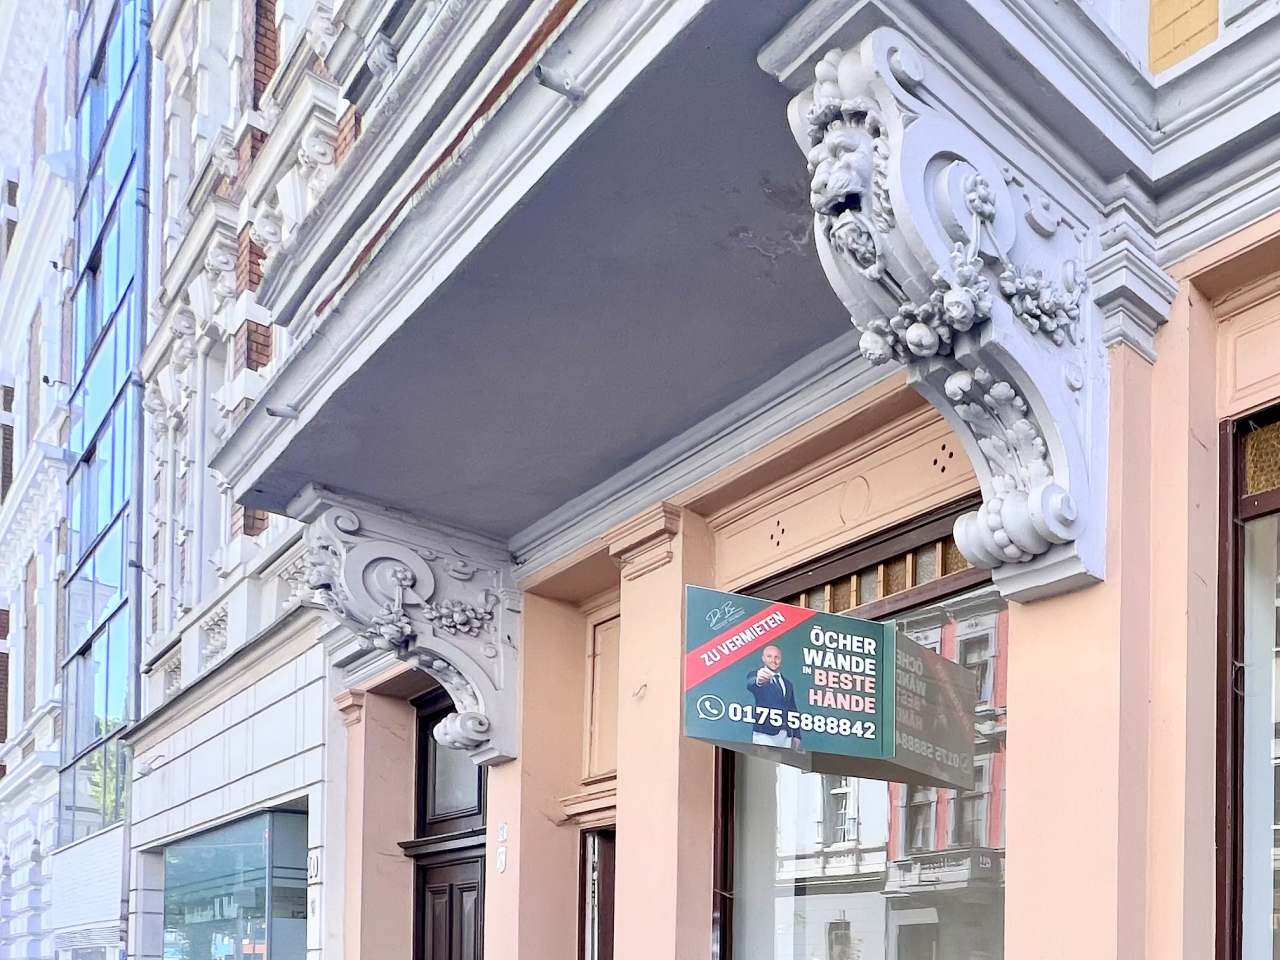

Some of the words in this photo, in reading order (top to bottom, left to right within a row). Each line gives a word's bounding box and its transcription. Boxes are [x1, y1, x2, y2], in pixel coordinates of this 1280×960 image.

[700, 649, 721, 667] ZU
[717, 611, 786, 656] VERMIETEN
[809, 625, 877, 656] ÖCHER
[802, 647, 877, 676] WÄNDE
[802, 665, 812, 675] IN
[814, 668, 876, 694] BESTE
[808, 687, 876, 714] HÄNDE
[728, 703, 783, 727] 0175
[787, 711, 876, 739] 5888842
